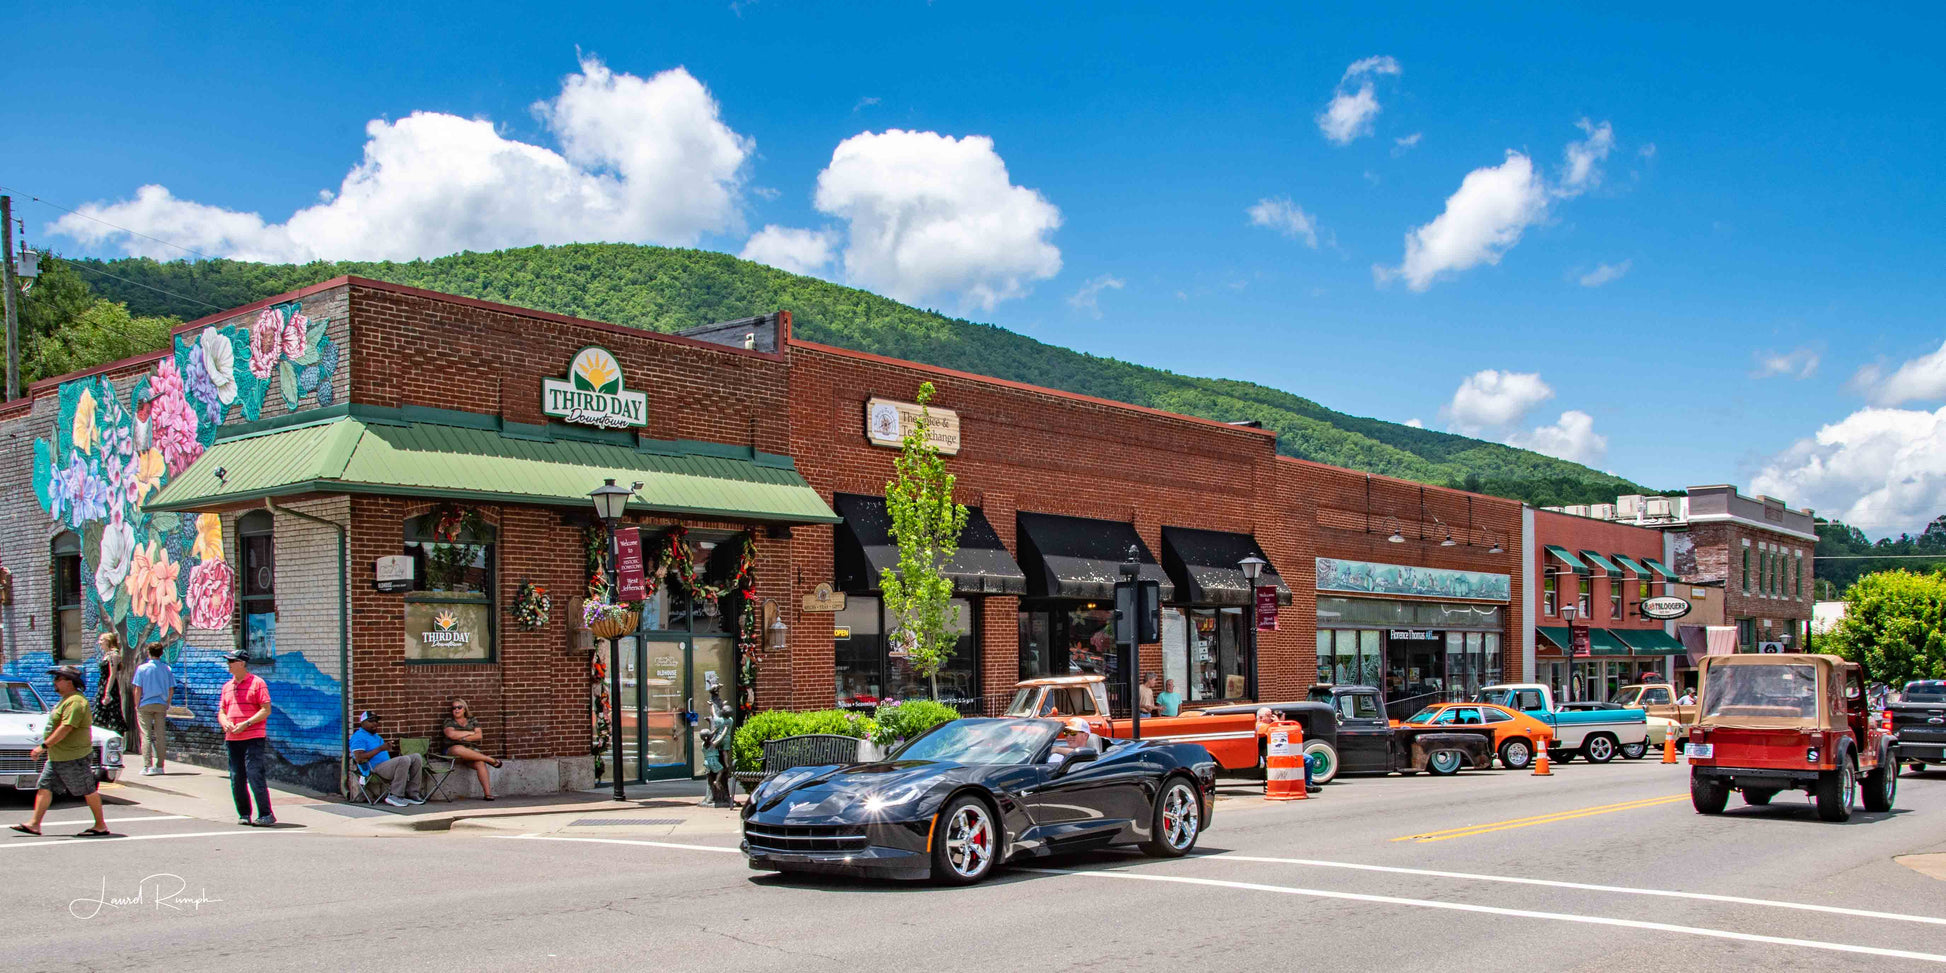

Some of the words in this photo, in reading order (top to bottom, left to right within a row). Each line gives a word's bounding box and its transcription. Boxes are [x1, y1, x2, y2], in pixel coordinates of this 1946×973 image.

[549, 388, 608, 413] THIRD
[610, 396, 643, 421] DAY
[567, 407, 628, 428] Downtown
[902, 411, 917, 423] The
[942, 418, 949, 428] &
[919, 430, 957, 446] xchange
[620, 539, 638, 547] Welcome
[421, 631, 452, 643] THIRD
[453, 632, 470, 643] DAY
[834, 629, 849, 637] OPEN
[1408, 629, 1425, 640] Thomas
